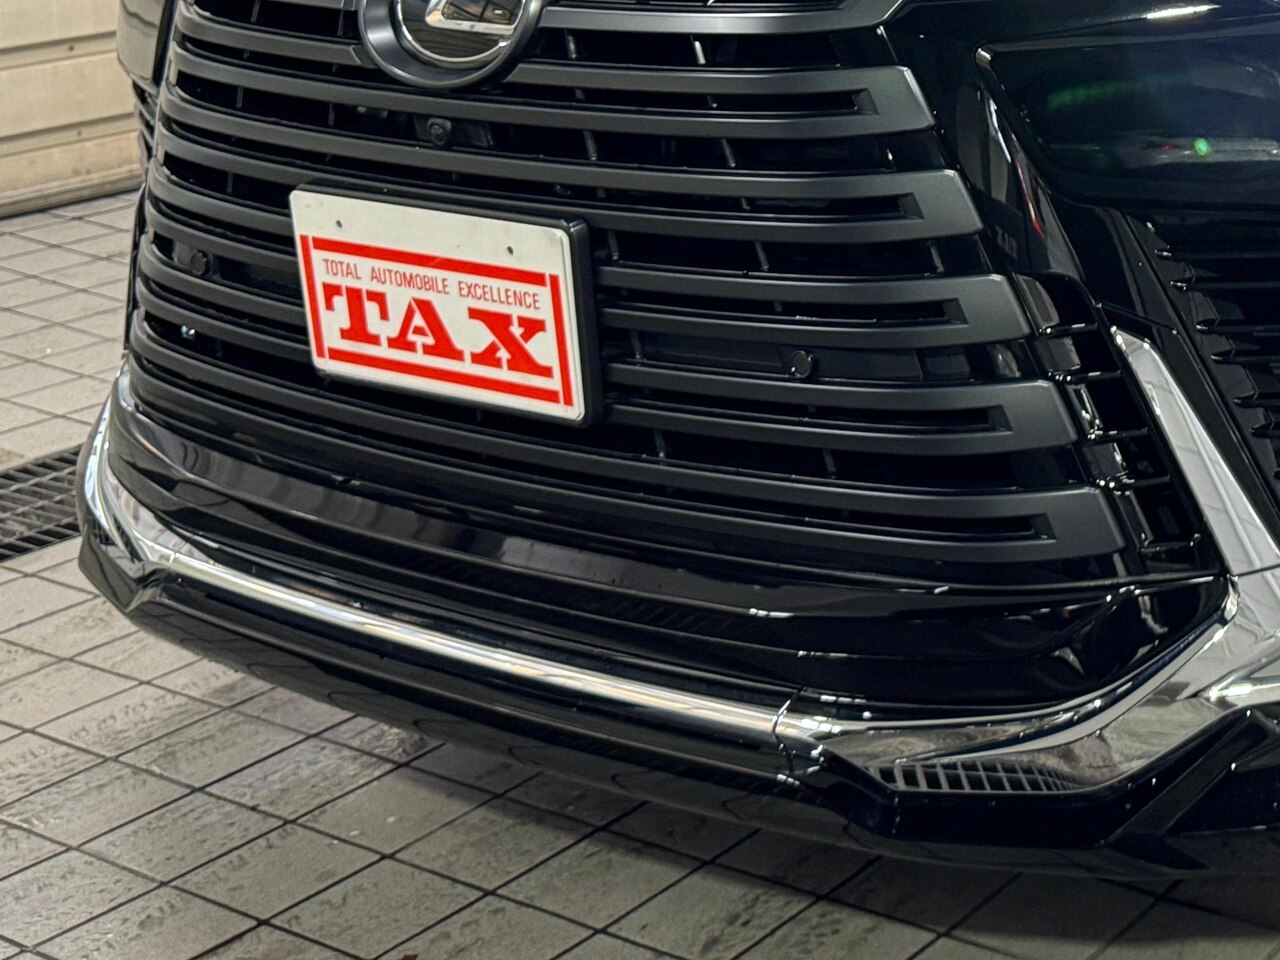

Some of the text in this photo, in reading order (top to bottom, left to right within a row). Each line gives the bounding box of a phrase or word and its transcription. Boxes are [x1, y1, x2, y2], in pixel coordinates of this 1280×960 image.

[322, 258, 540, 310] TOTAL AUTOMOBILE EXCELLENCE
[322, 282, 554, 379] TAX
